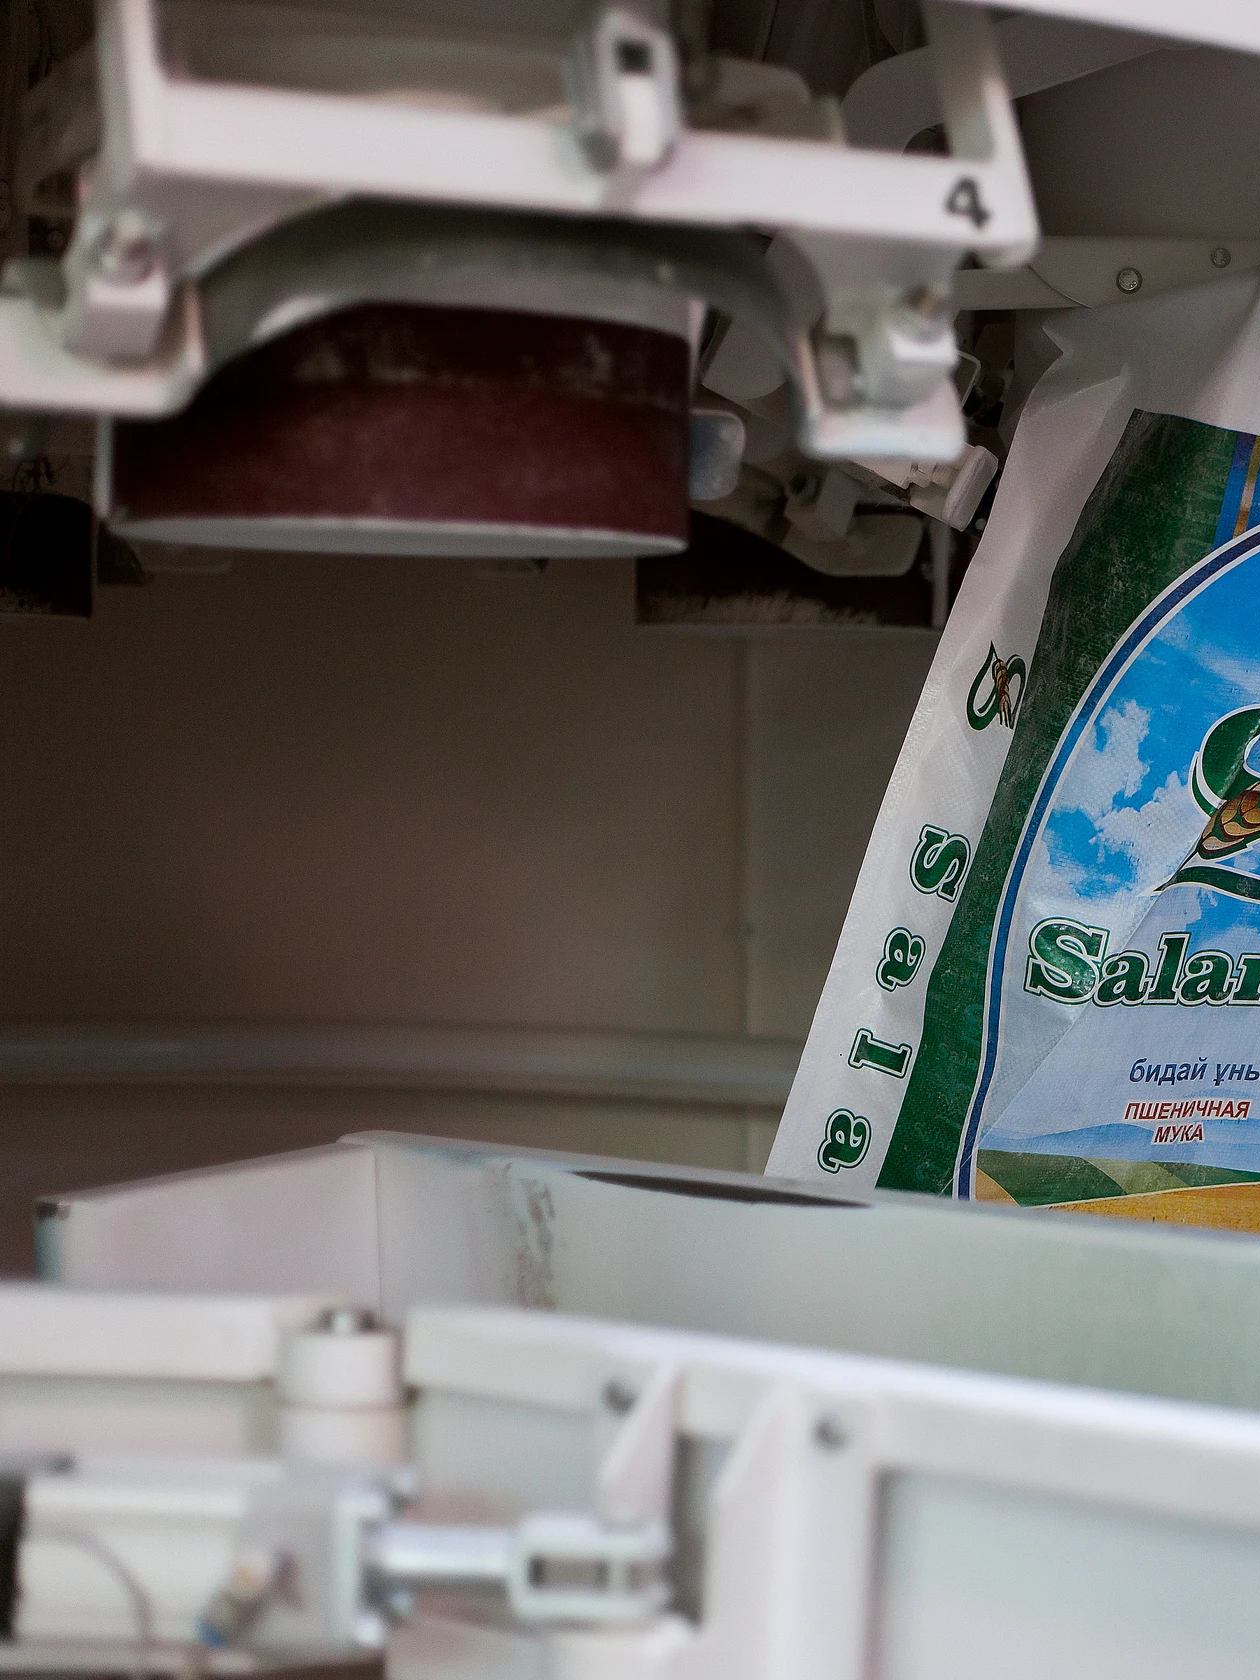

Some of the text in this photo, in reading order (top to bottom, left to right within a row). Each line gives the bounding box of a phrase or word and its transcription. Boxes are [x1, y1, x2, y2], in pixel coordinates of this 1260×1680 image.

[943, 175, 992, 230] 4
[1129, 1057, 1208, 1086] бидай
[1123, 1099, 1251, 1121] ПШЕНИЧНАЯ
[1153, 1123, 1203, 1144] МУКА
